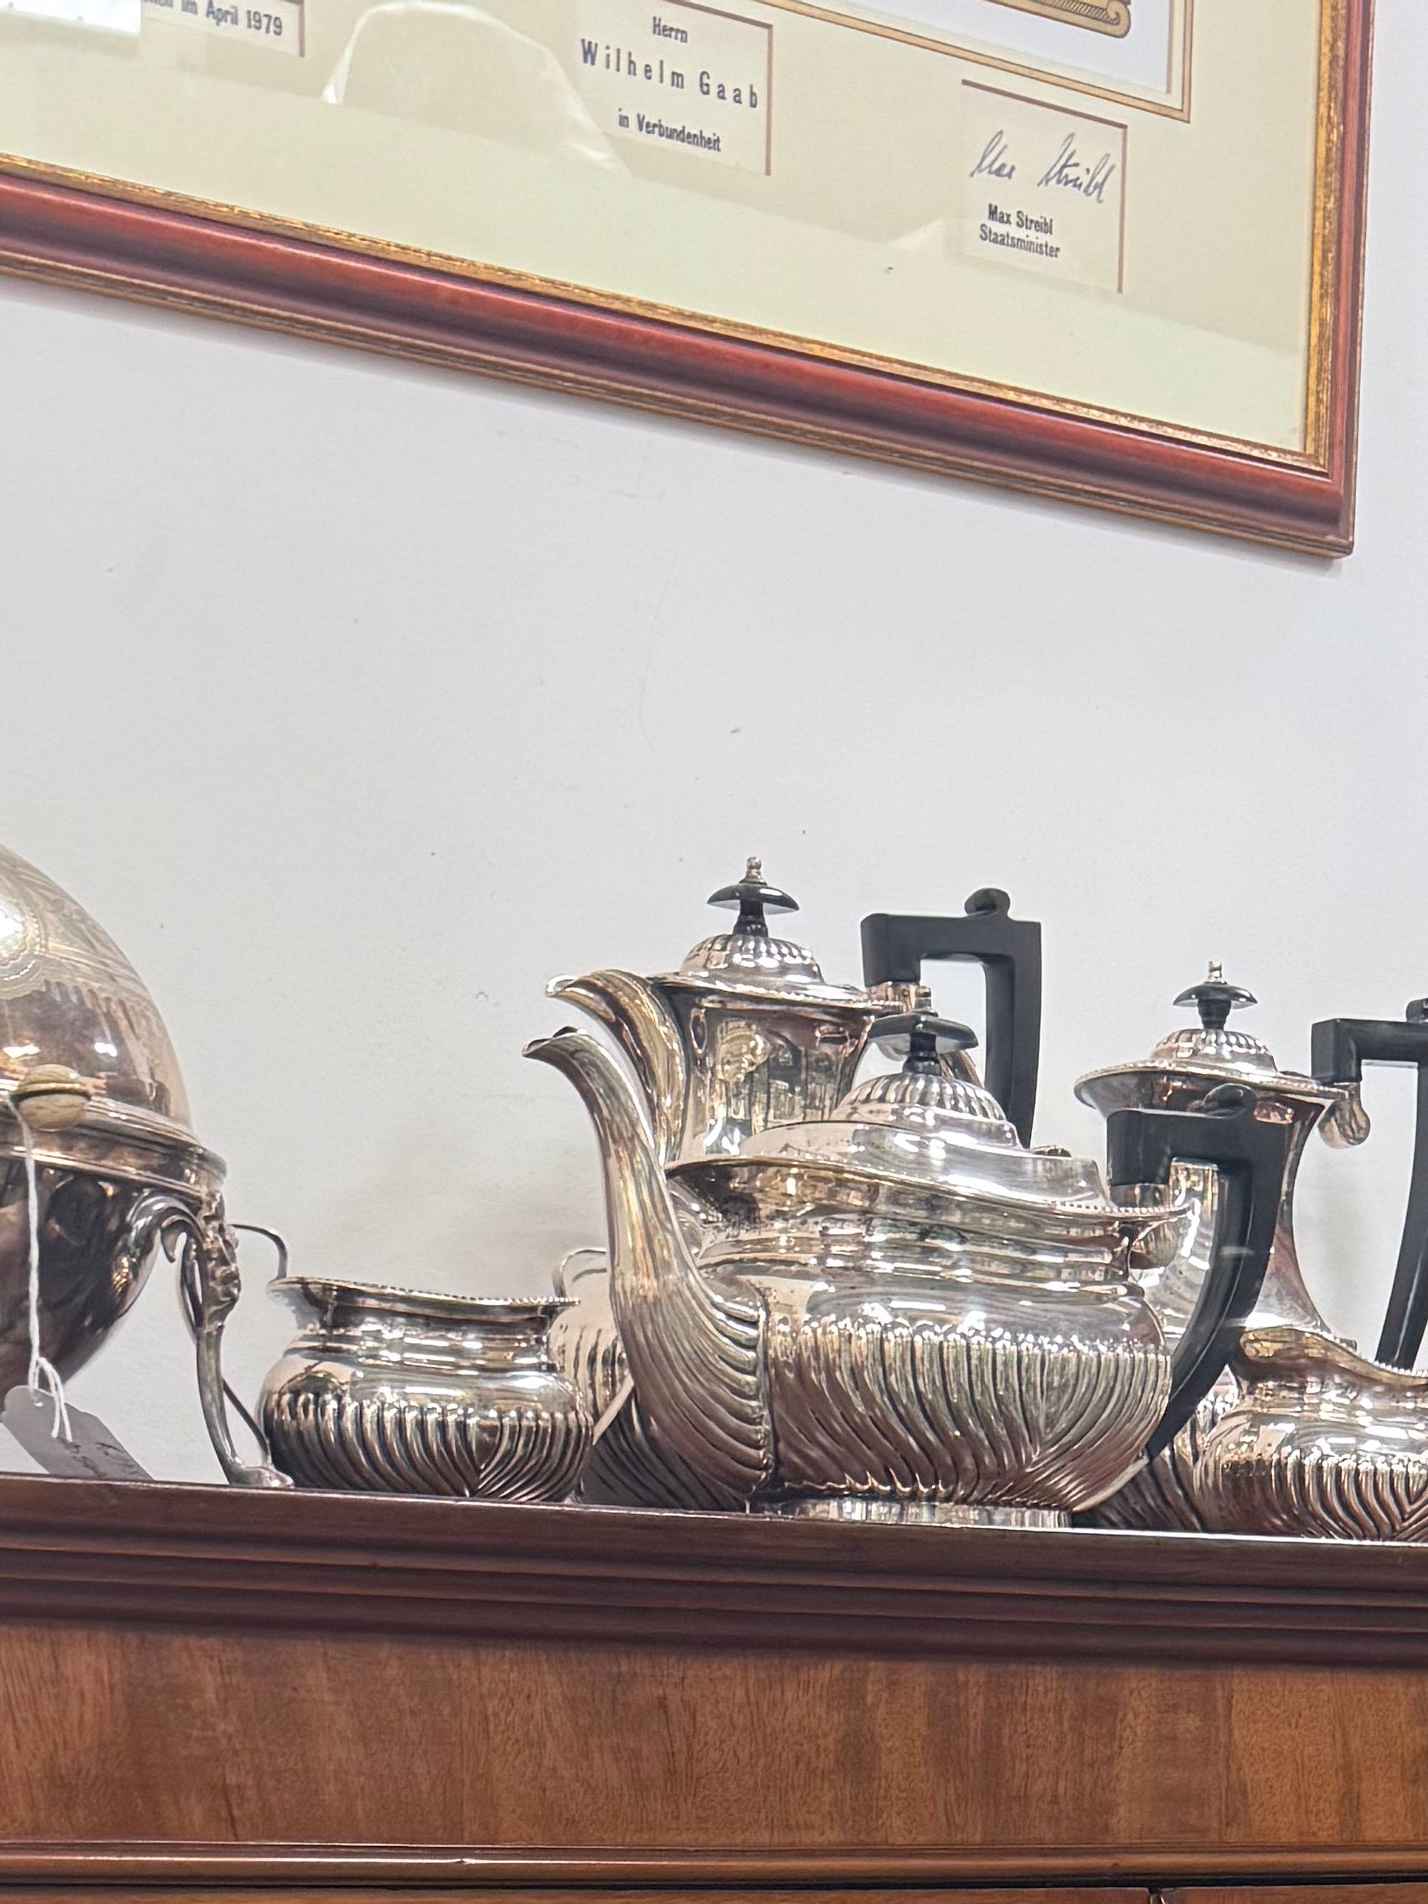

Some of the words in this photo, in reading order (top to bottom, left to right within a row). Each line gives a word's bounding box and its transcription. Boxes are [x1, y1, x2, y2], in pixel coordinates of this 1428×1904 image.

[206, 0, 238, 26] April
[246, 10, 283, 36] 1979
[653, 16, 688, 43] Herrn
[581, 38, 684, 89] Wilhelm
[699, 70, 758, 109] Gaab
[619, 107, 630, 128] in
[637, 113, 722, 152] Verbundenheit
[988, 203, 1012, 225] Max
[1016, 210, 1053, 235] Streibl
[980, 223, 1061, 259] Staatsminister
